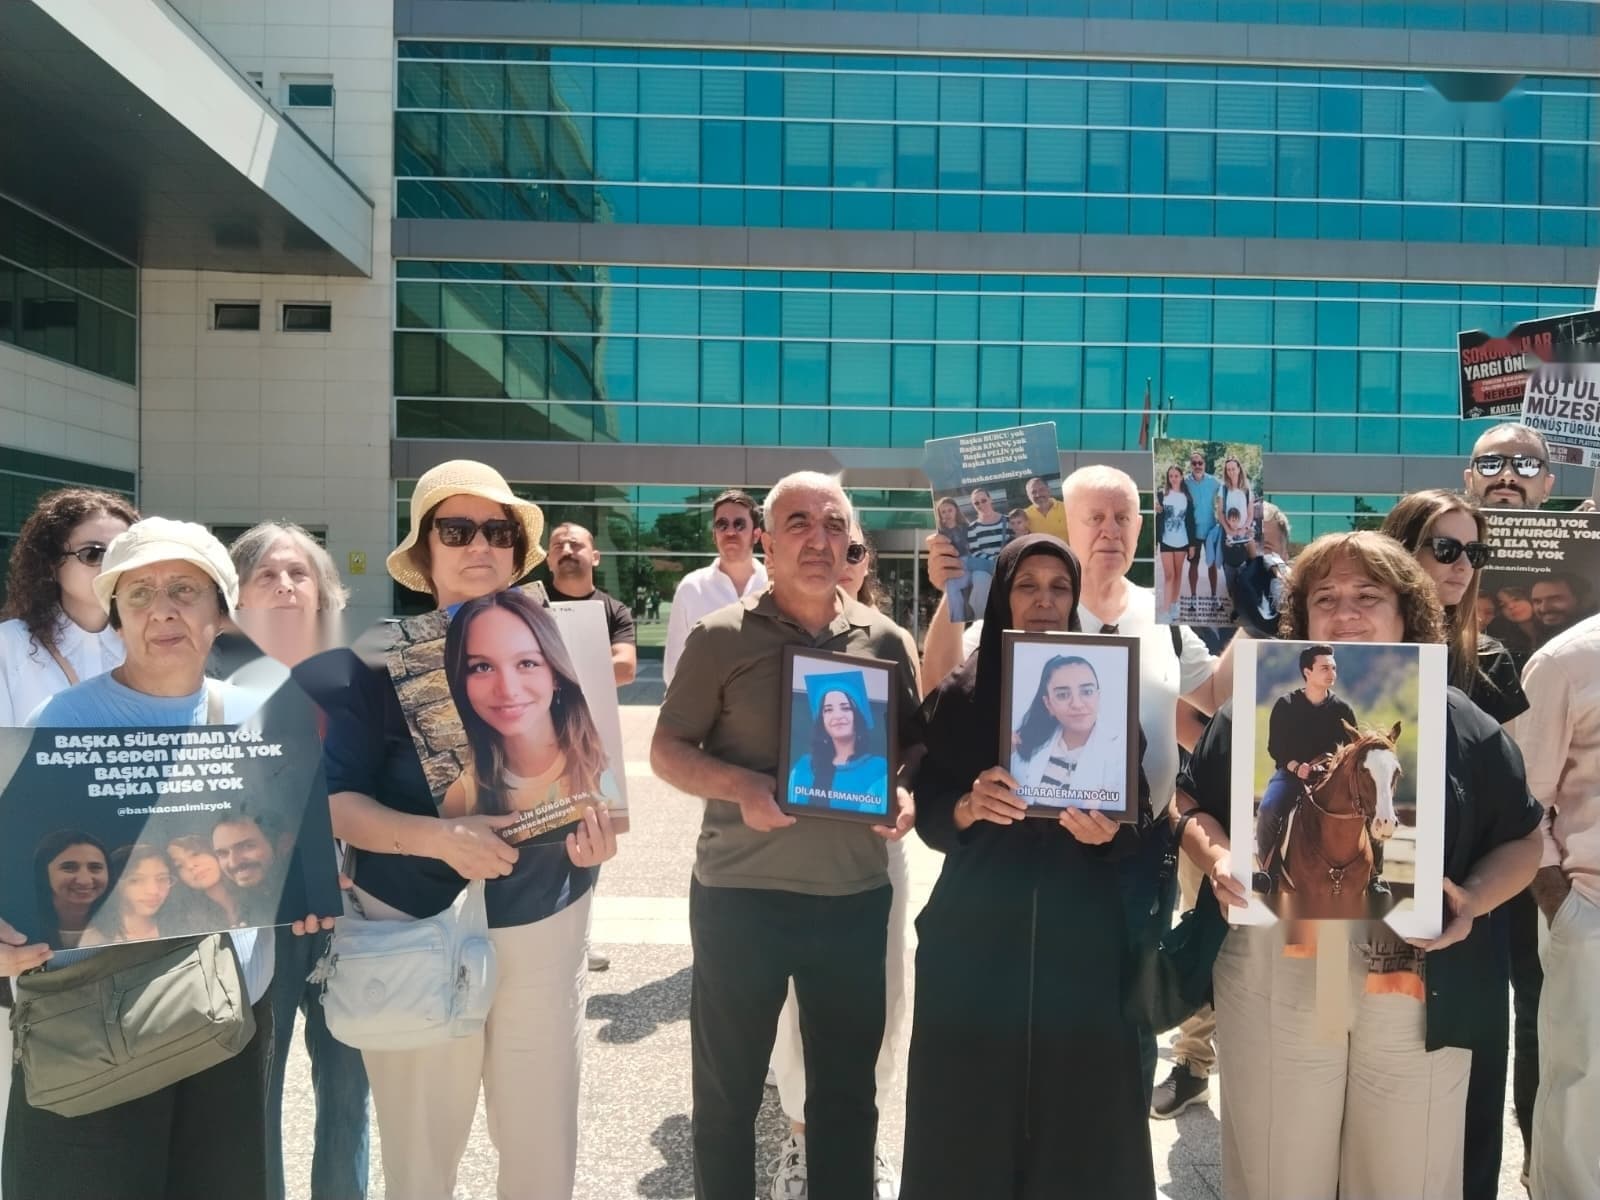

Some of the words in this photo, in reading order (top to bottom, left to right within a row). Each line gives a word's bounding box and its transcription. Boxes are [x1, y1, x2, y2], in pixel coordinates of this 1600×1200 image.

[1464, 362, 1502, 382] YARGI
[1490, 403, 1523, 415] KARTAL
[1560, 519, 1589, 528] YOK
[1513, 528, 1570, 538] NURGÜL
[1573, 530, 1600, 540] YOK
[1504, 539, 1528, 548] ELA
[1532, 540, 1560, 549] YOK
[1536, 551, 1565, 560] YOK
[55, 735, 121, 752] BAŞKA
[227, 730, 264, 744] YOK
[36, 751, 103, 768] BAŞKA
[171, 745, 245, 761] NURGÜL
[246, 744, 282, 758] YOK
[94, 765, 159, 782] BAŞKA
[162, 764, 195, 778] ELA
[198, 762, 234, 776] YOK
[87, 782, 153, 799] BAŞKA
[207, 777, 244, 791] YOK
[795, 785, 827, 798] DİLARA
[828, 791, 881, 804] ERMANOĞLU
[1017, 785, 1053, 798] DİLARA
[1055, 788, 1119, 801] ERMANOĞLU
[117, 801, 232, 816] @baskacanimizyok
